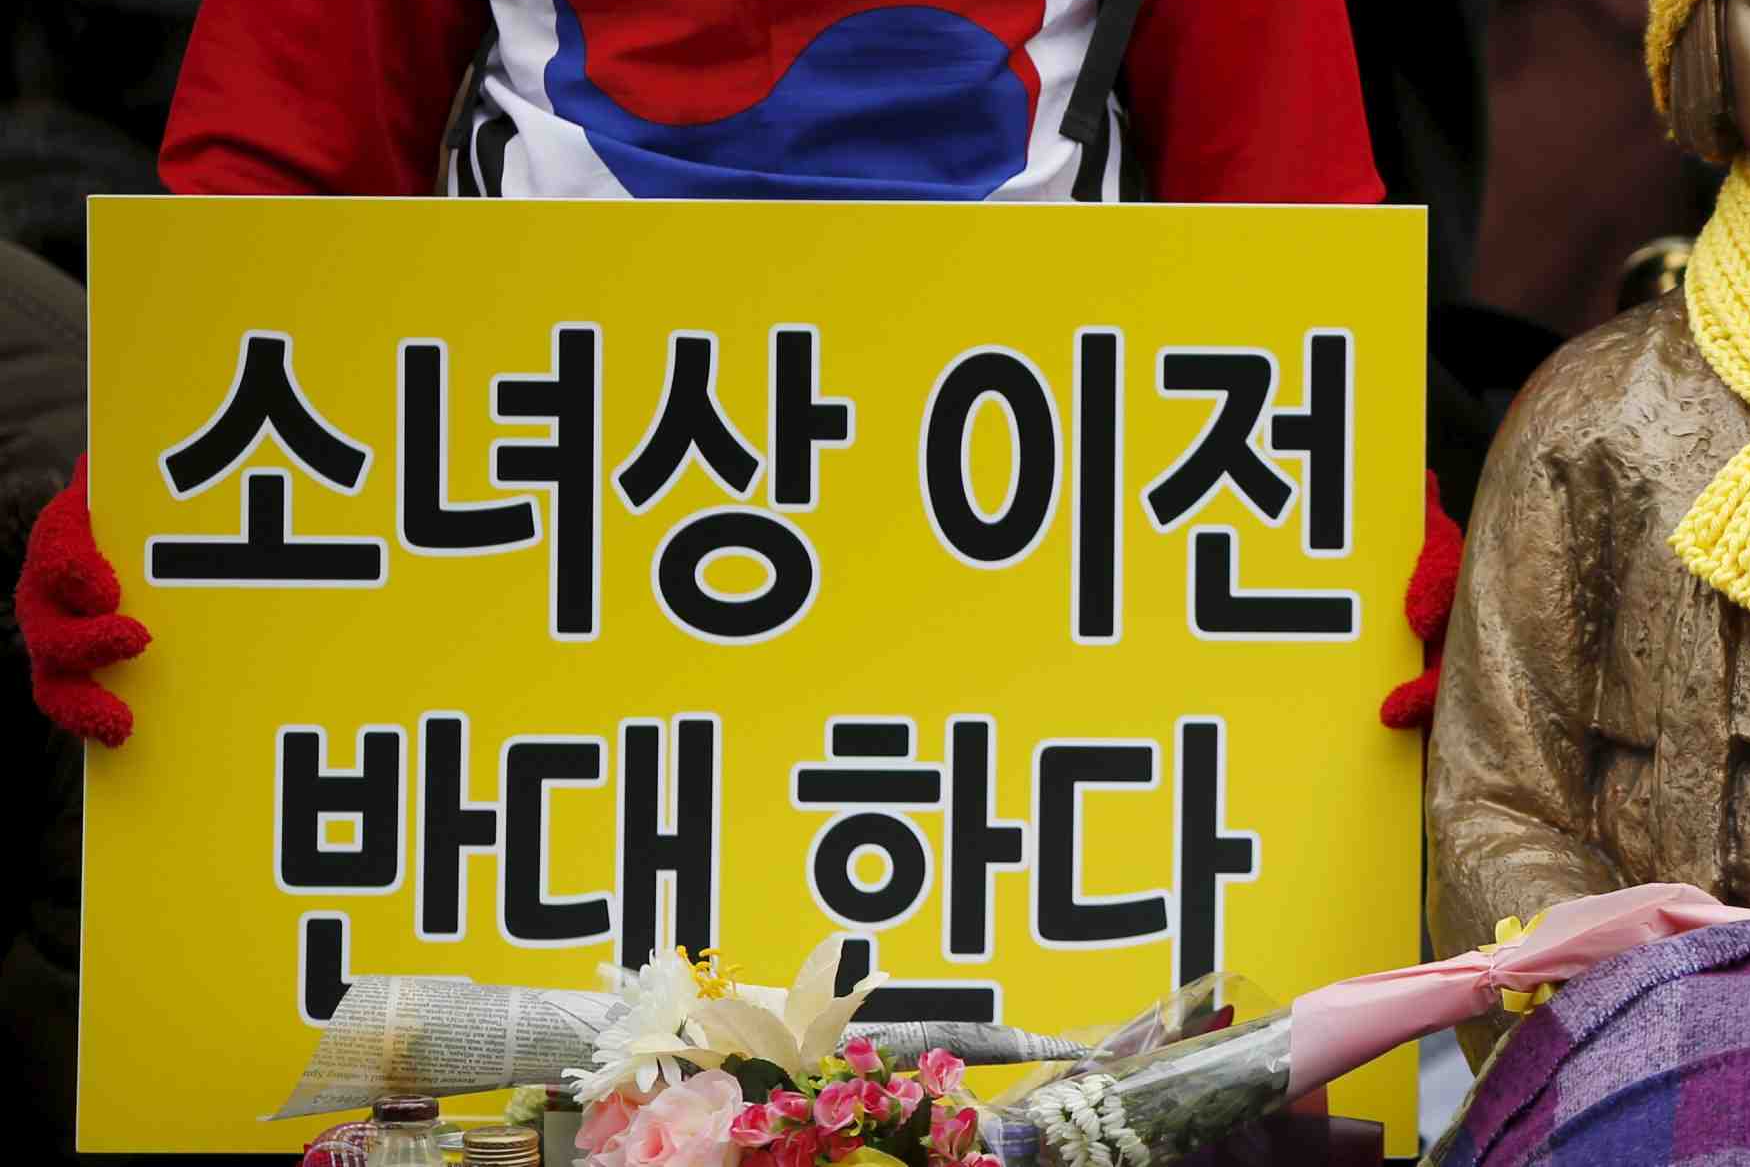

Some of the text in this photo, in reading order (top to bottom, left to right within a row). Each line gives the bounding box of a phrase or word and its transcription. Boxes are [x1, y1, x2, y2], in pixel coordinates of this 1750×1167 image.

[147, 324, 1360, 644] 소녀상 이전
[273, 711, 1260, 1025] 반대 한다
